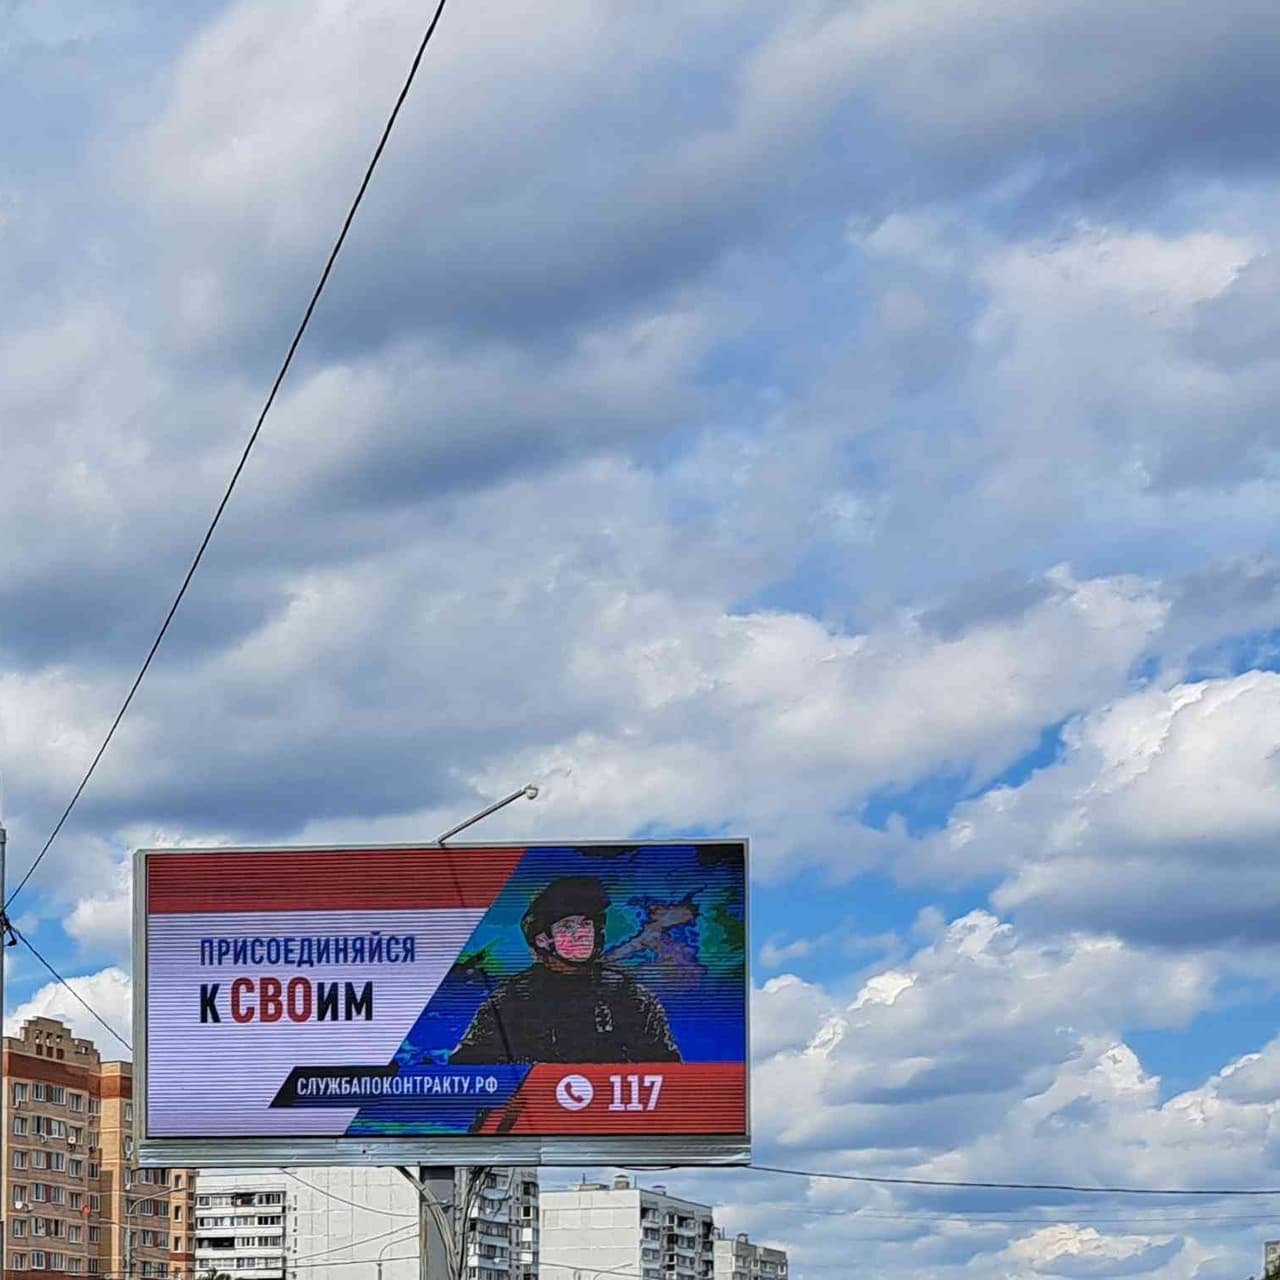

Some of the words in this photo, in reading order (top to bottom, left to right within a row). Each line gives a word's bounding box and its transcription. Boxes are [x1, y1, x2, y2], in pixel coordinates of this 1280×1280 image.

[200, 931, 416, 967] ПРИСОЕДИНЯЙСЯ
[200, 982, 221, 1024] К
[230, 975, 374, 1024] СВОИМ
[296, 1075, 499, 1097] СЛУЖБАПОКОНТРАКТУ.РФ
[608, 1074, 665, 1112] 117
